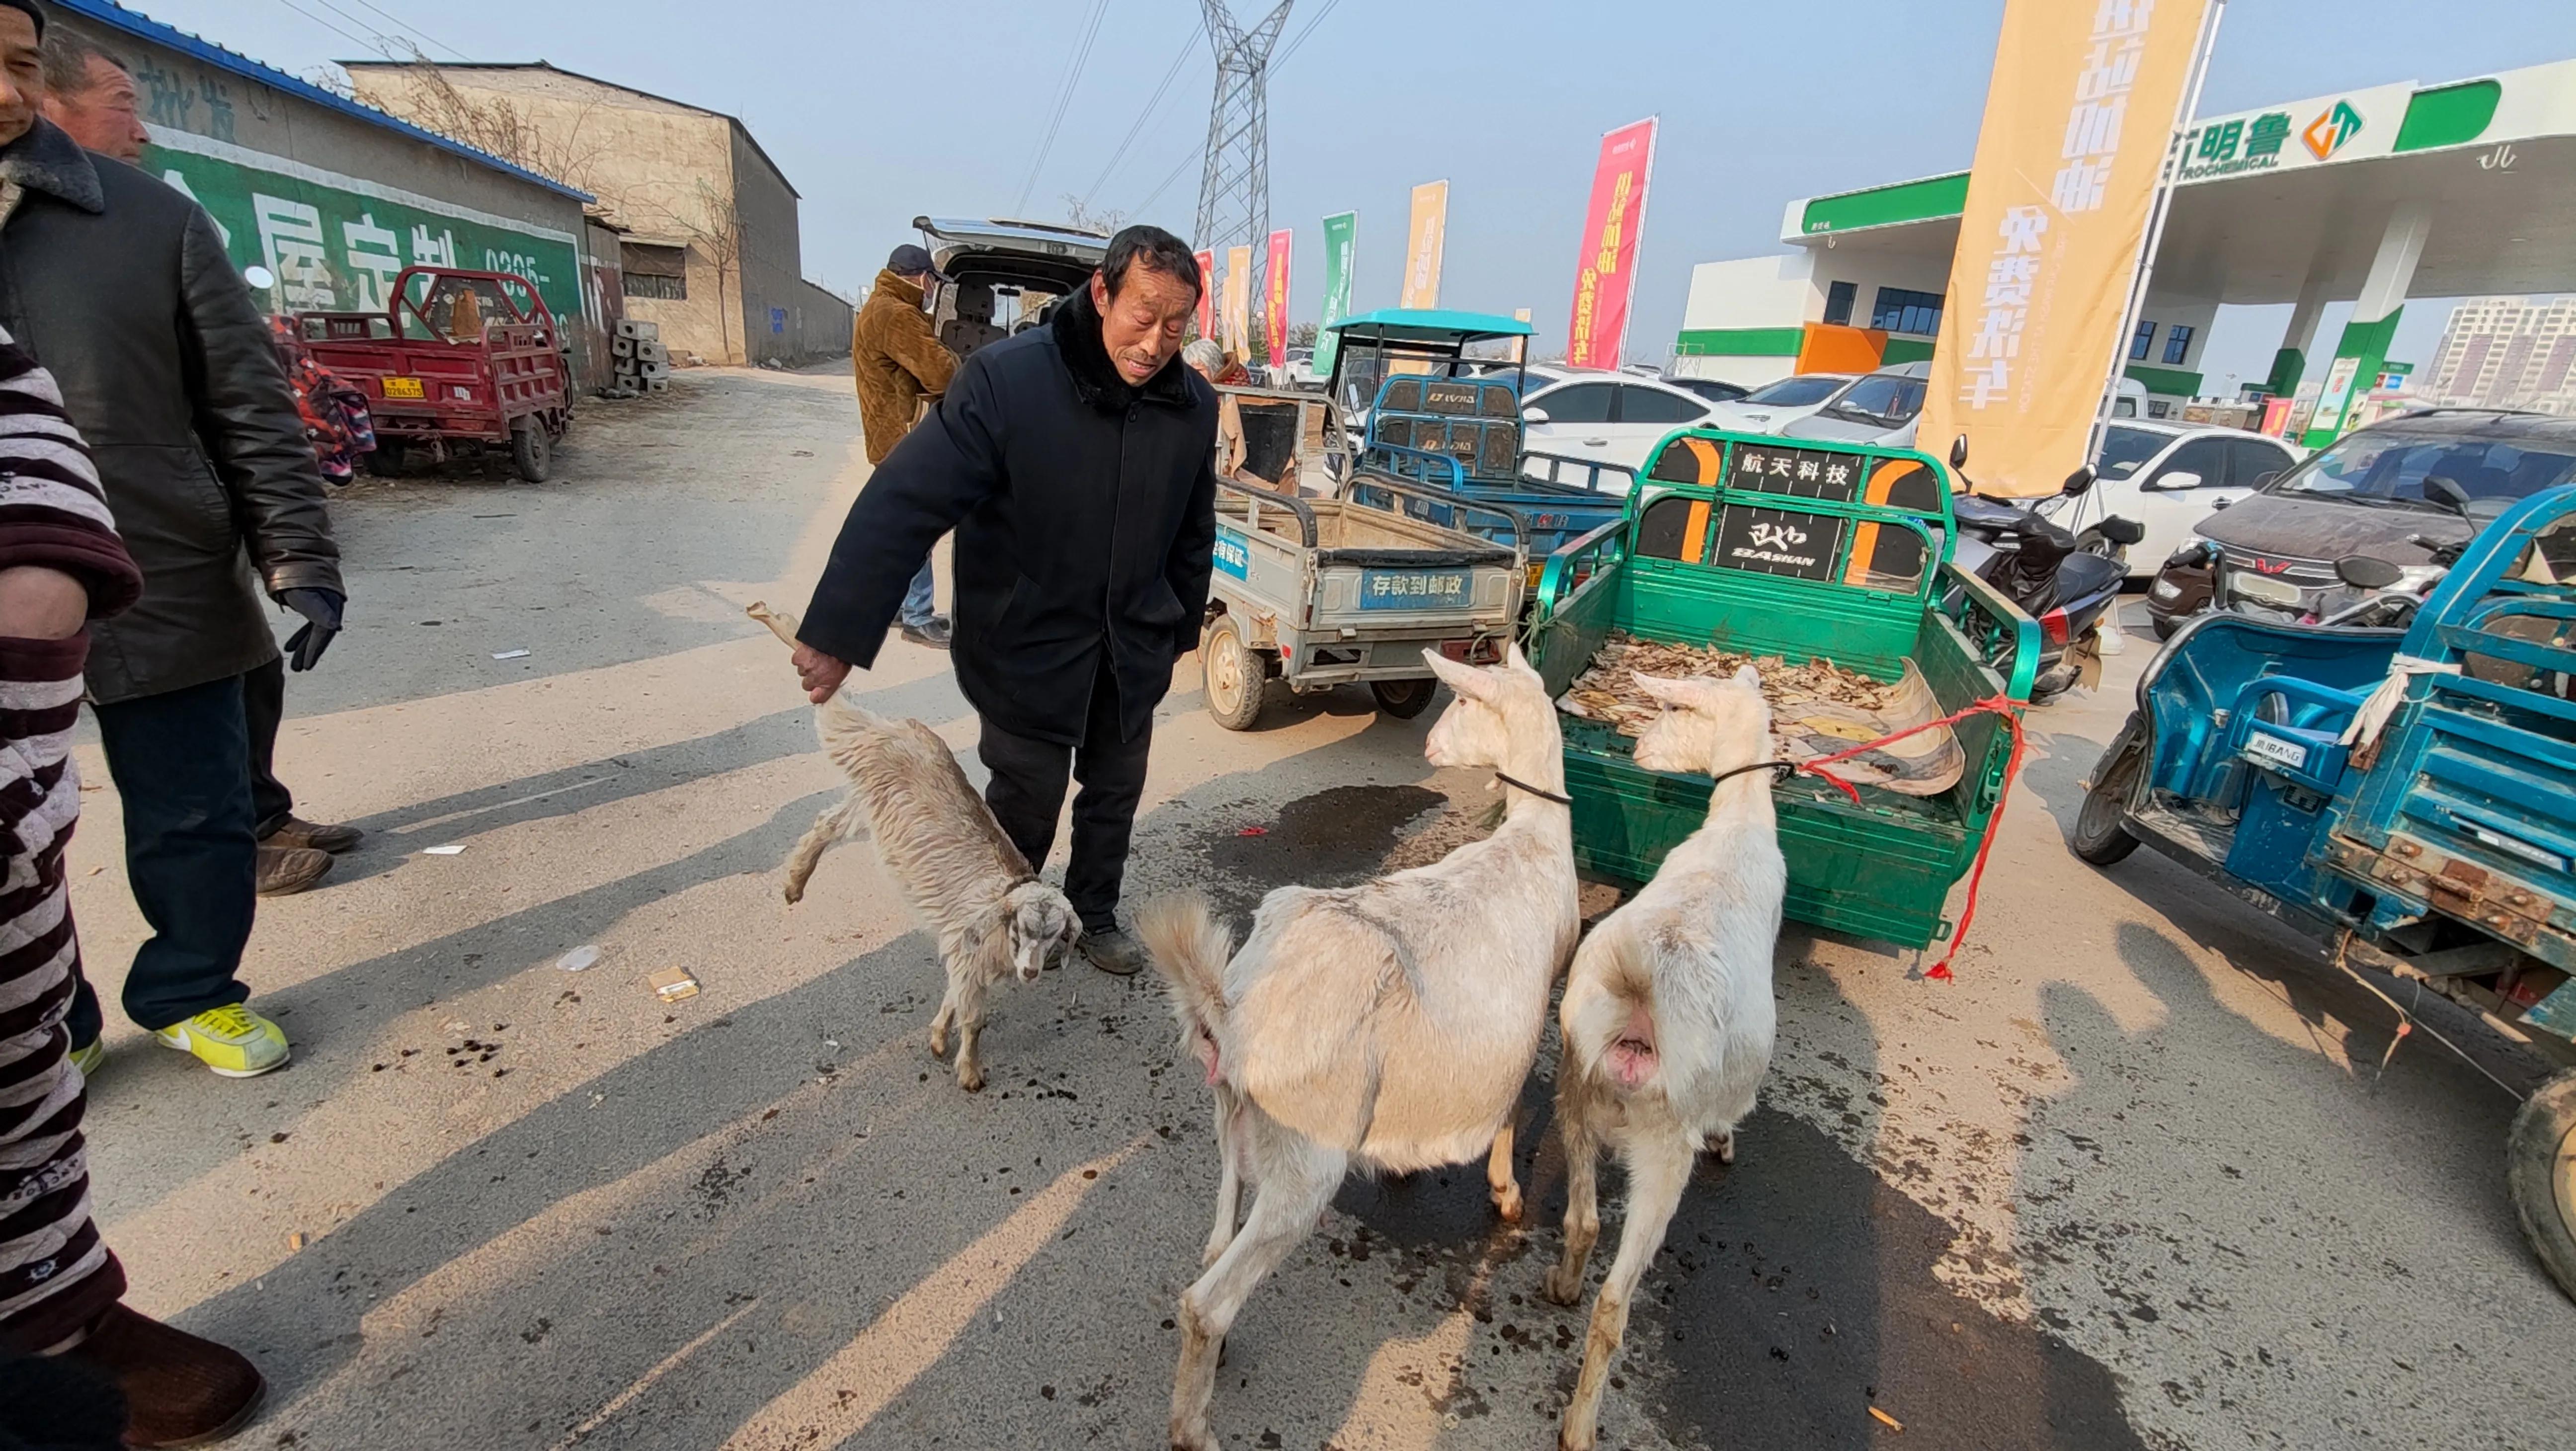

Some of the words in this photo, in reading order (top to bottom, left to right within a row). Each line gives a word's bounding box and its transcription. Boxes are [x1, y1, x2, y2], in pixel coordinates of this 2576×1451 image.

[164, 169, 456, 328] 屋定制
[1742, 452, 1850, 485] 航天科技
[1731, 547, 1816, 567] BASHAN
[1372, 574, 1463, 596] 存款到邮政
